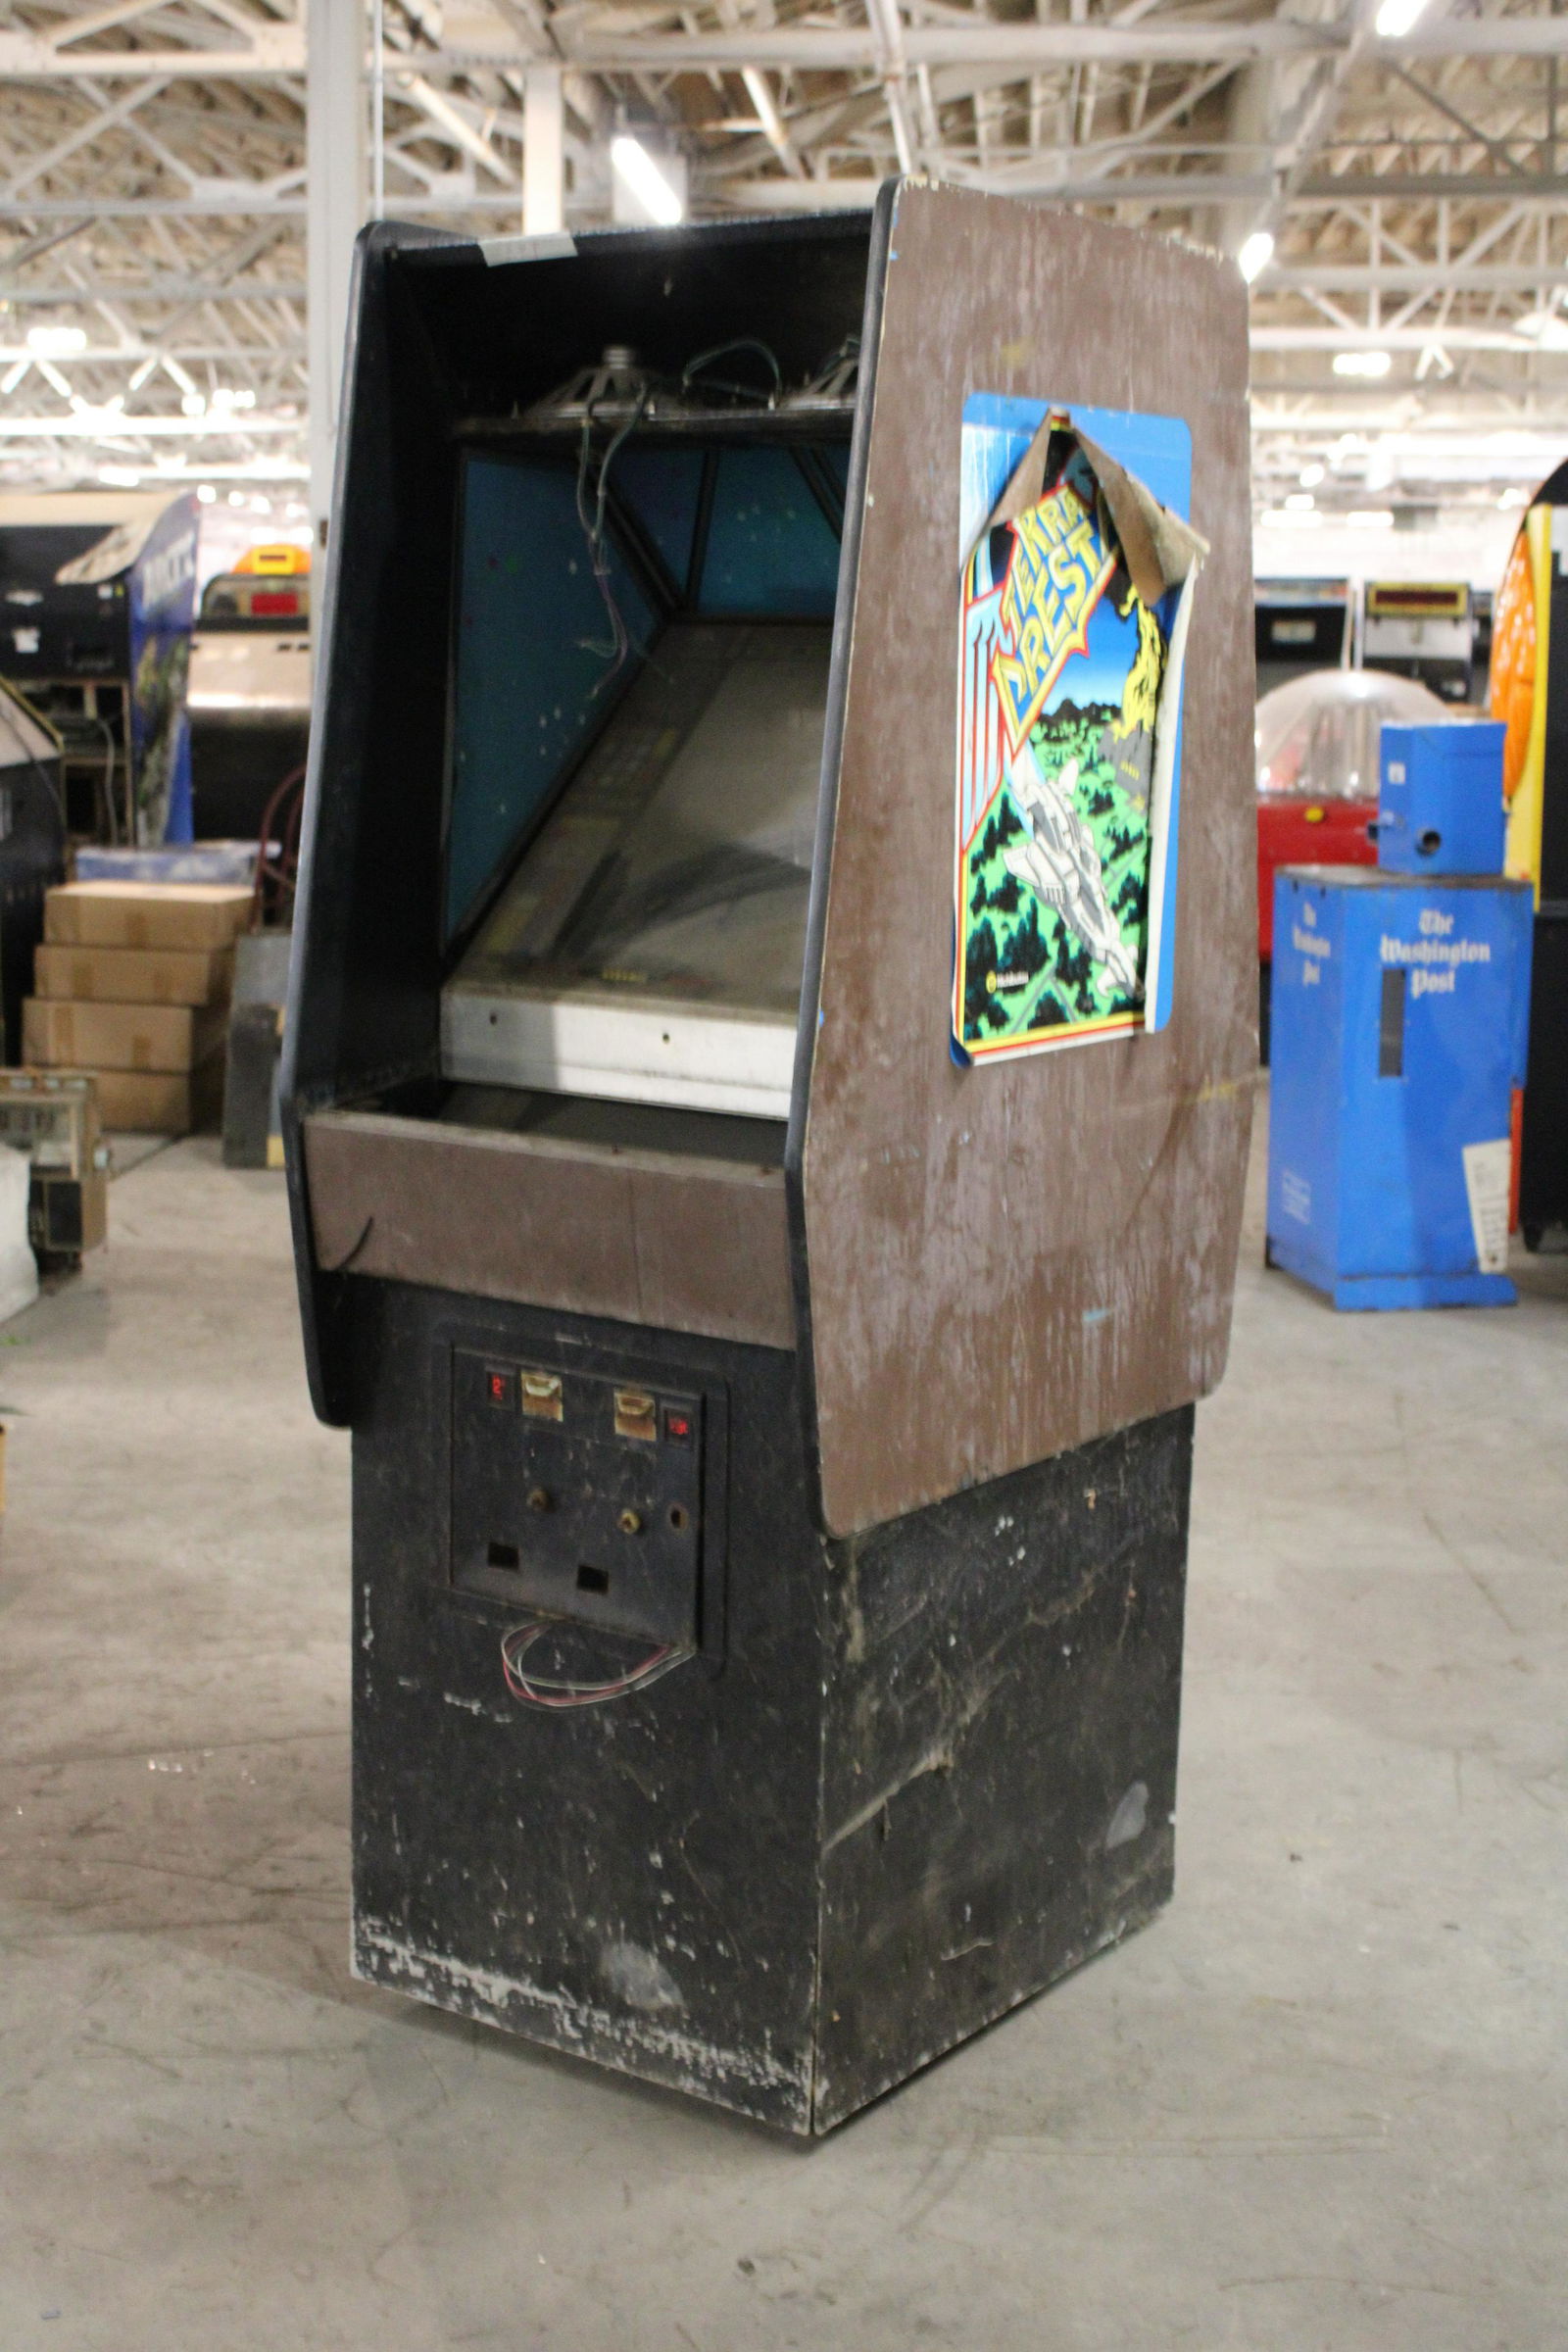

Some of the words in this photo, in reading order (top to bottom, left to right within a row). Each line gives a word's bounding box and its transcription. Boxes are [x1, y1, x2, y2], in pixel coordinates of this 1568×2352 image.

[1002, 484, 1091, 649] TERRA
[992, 522, 1115, 741] CREST
[1419, 907, 1454, 936] The
[1380, 934, 1491, 968] Washington
[1412, 968, 1455, 999] Post
